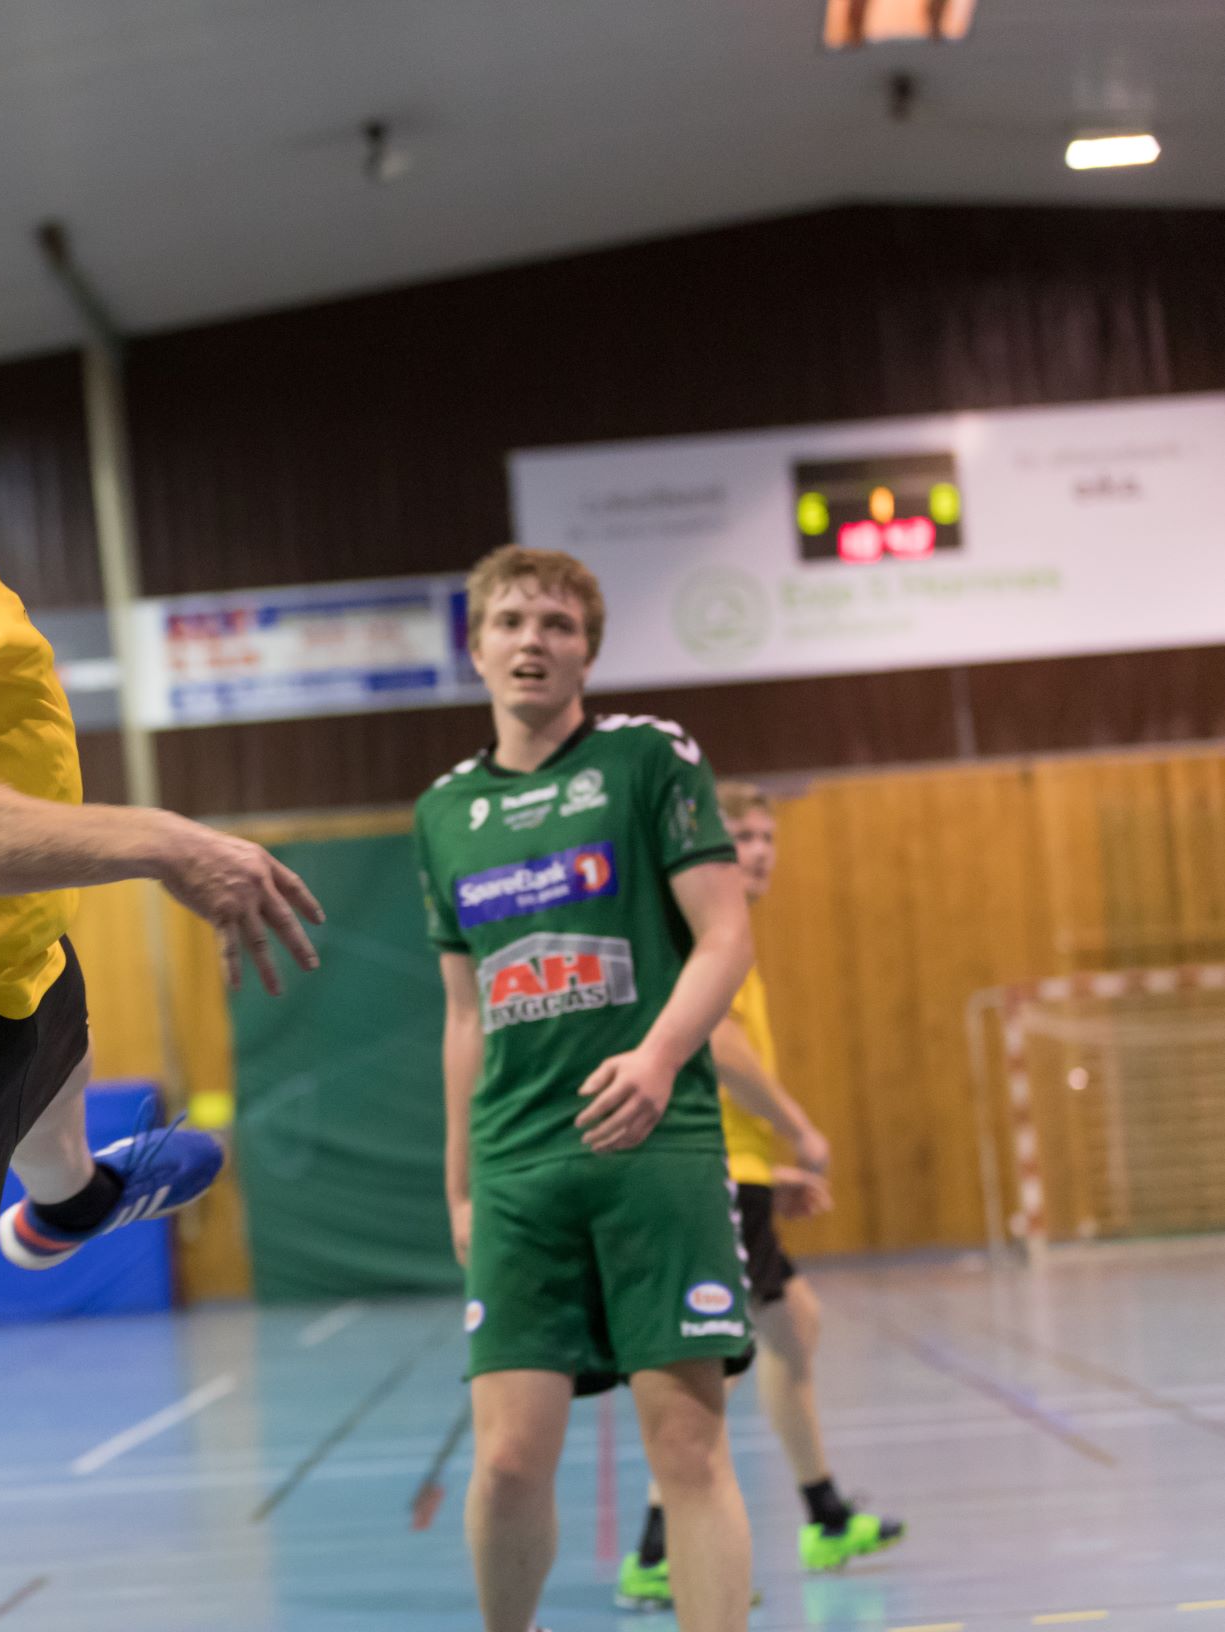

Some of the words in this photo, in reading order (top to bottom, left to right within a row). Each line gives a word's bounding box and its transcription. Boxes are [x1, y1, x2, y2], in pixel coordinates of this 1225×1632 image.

[469, 798, 490, 831] 9
[580, 858, 598, 885] 1
[490, 954, 601, 1006] AH
